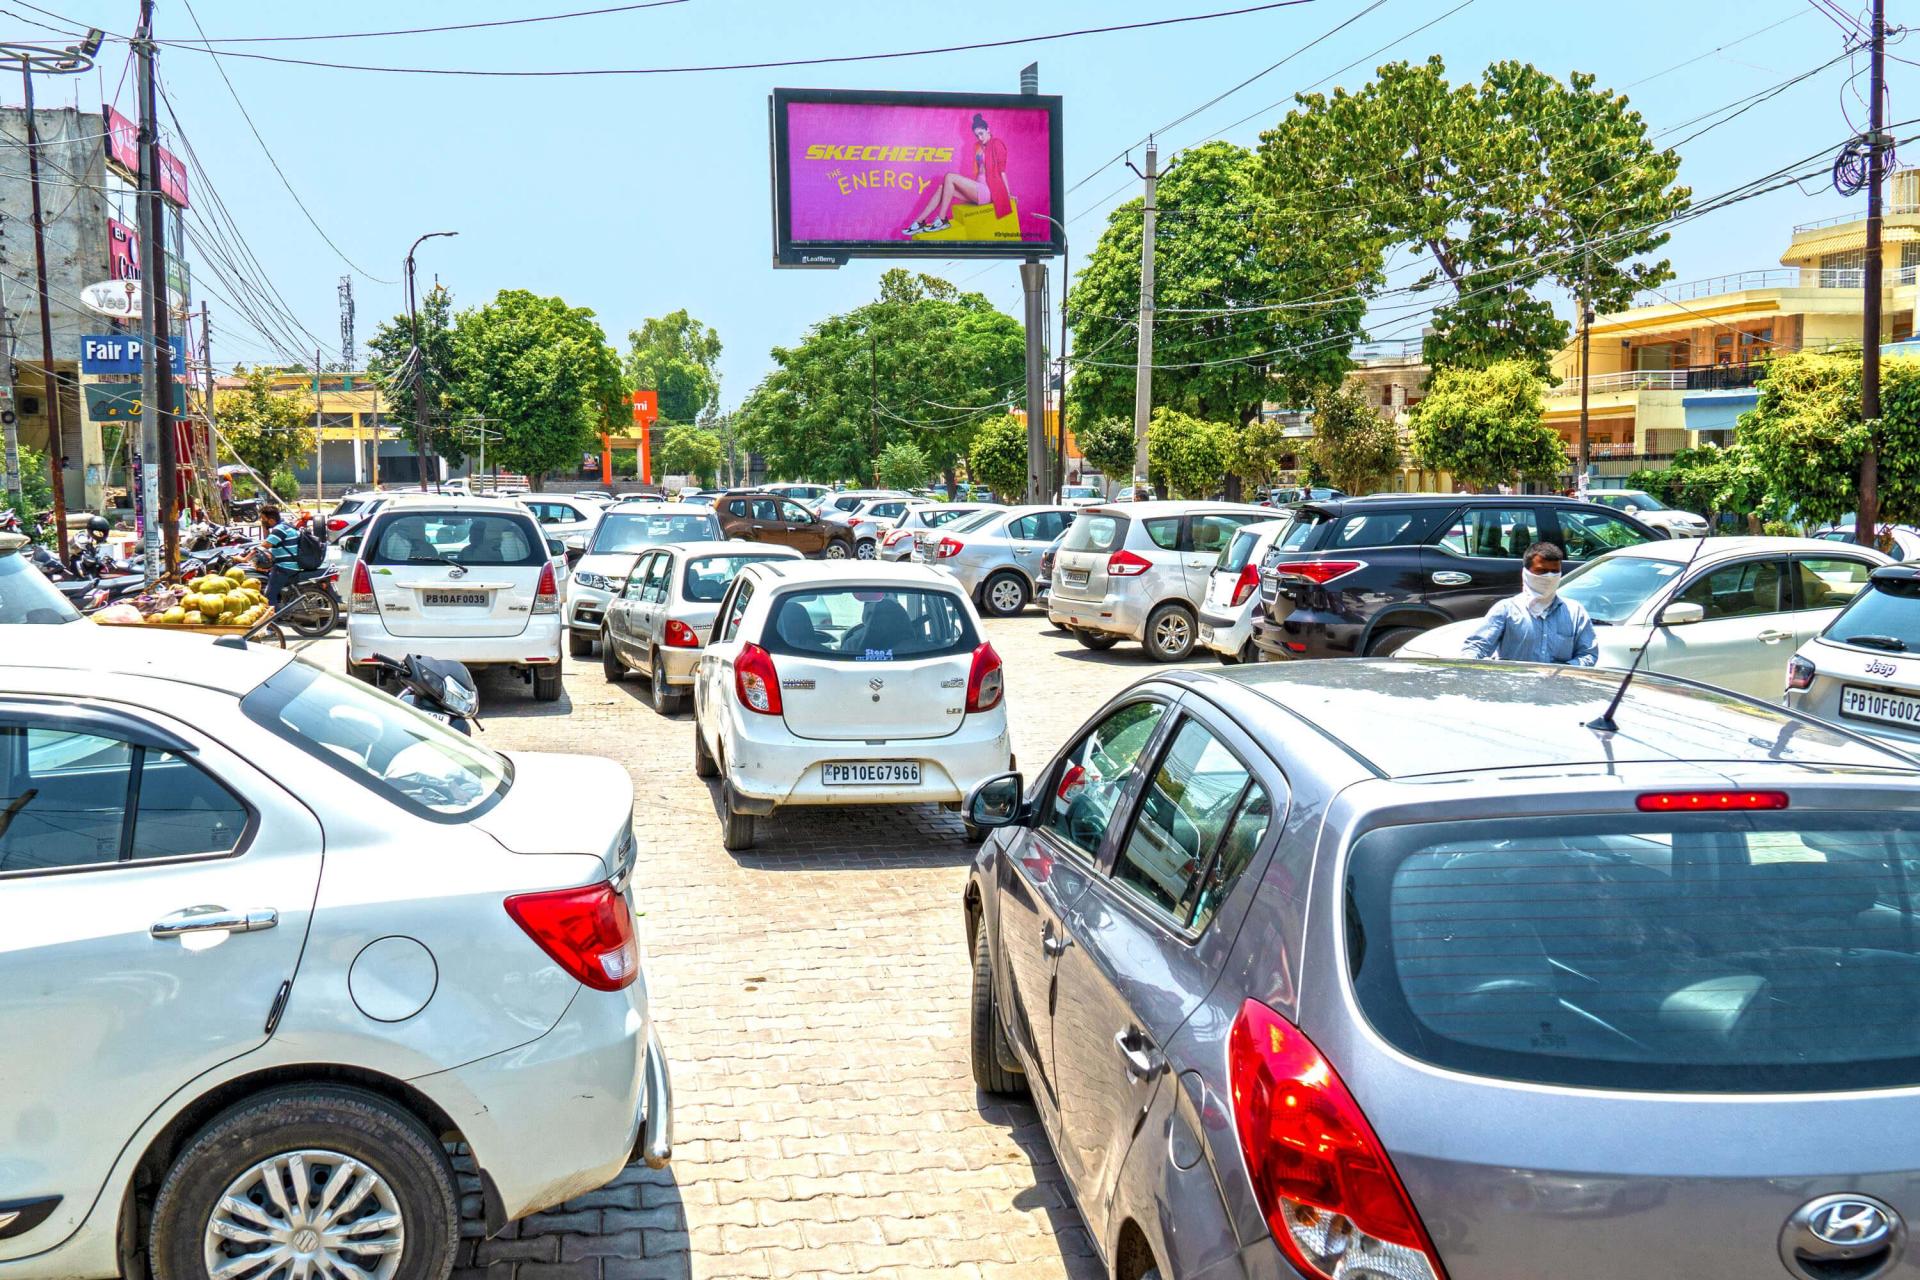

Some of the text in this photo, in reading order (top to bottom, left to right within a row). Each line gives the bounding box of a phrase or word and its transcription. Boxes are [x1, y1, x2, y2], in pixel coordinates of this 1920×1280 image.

[805, 144, 954, 162] SKECHERS
[827, 168, 842, 180] THE
[838, 170, 931, 195] ENERGY
[86, 341, 122, 360] Fair
[1865, 659, 1897, 678] Jeep
[833, 766, 918, 781] PB10EG7966
